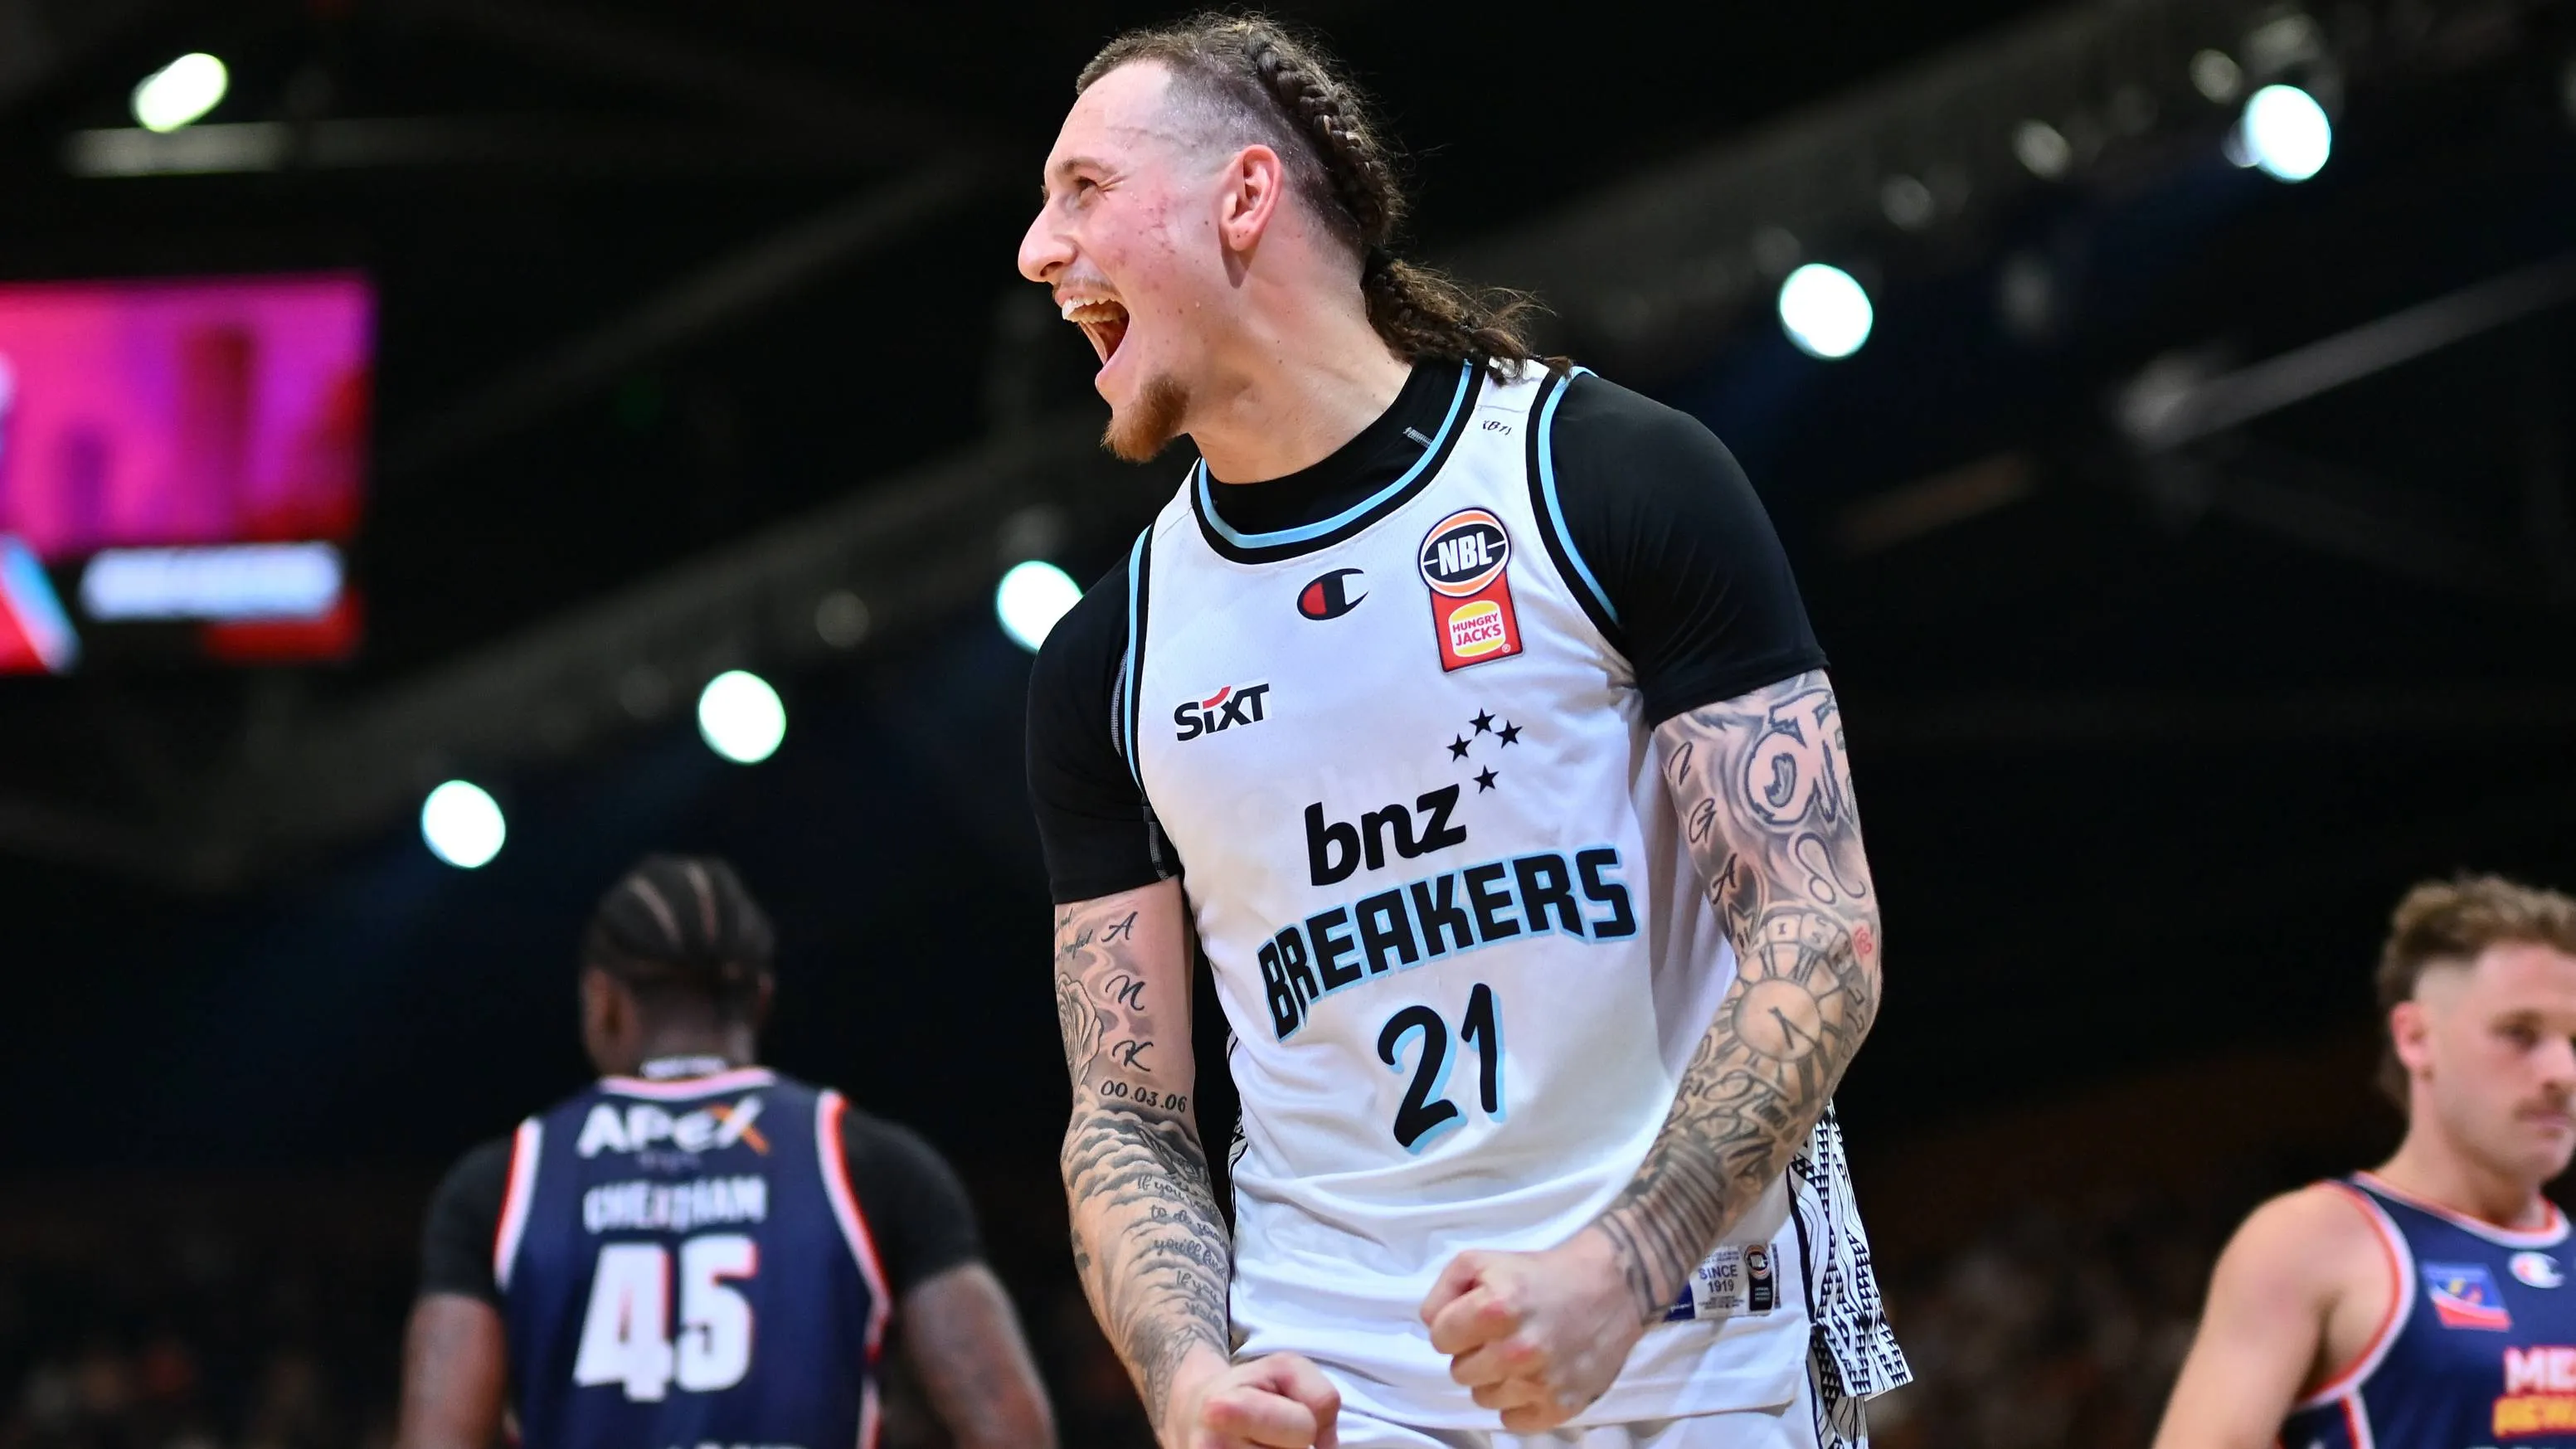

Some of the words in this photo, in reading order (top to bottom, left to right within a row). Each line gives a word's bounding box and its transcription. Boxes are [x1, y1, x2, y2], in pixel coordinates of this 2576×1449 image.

[1437, 531, 1493, 576] NBL
[1452, 613, 1498, 633] HUNGRY
[1456, 624, 1502, 646] JACK'S
[1304, 784, 1467, 887] bnz
[1101, 912, 1138, 943] A
[1256, 844, 1639, 1043] BREAKERS
[1377, 983, 1504, 1153] 21
[1101, 1080, 1188, 1113] 00.03.06
[1699, 1264, 1739, 1280] SINCE
[1707, 1278, 1735, 1293] 1919
[572, 1233, 761, 1402] 45
